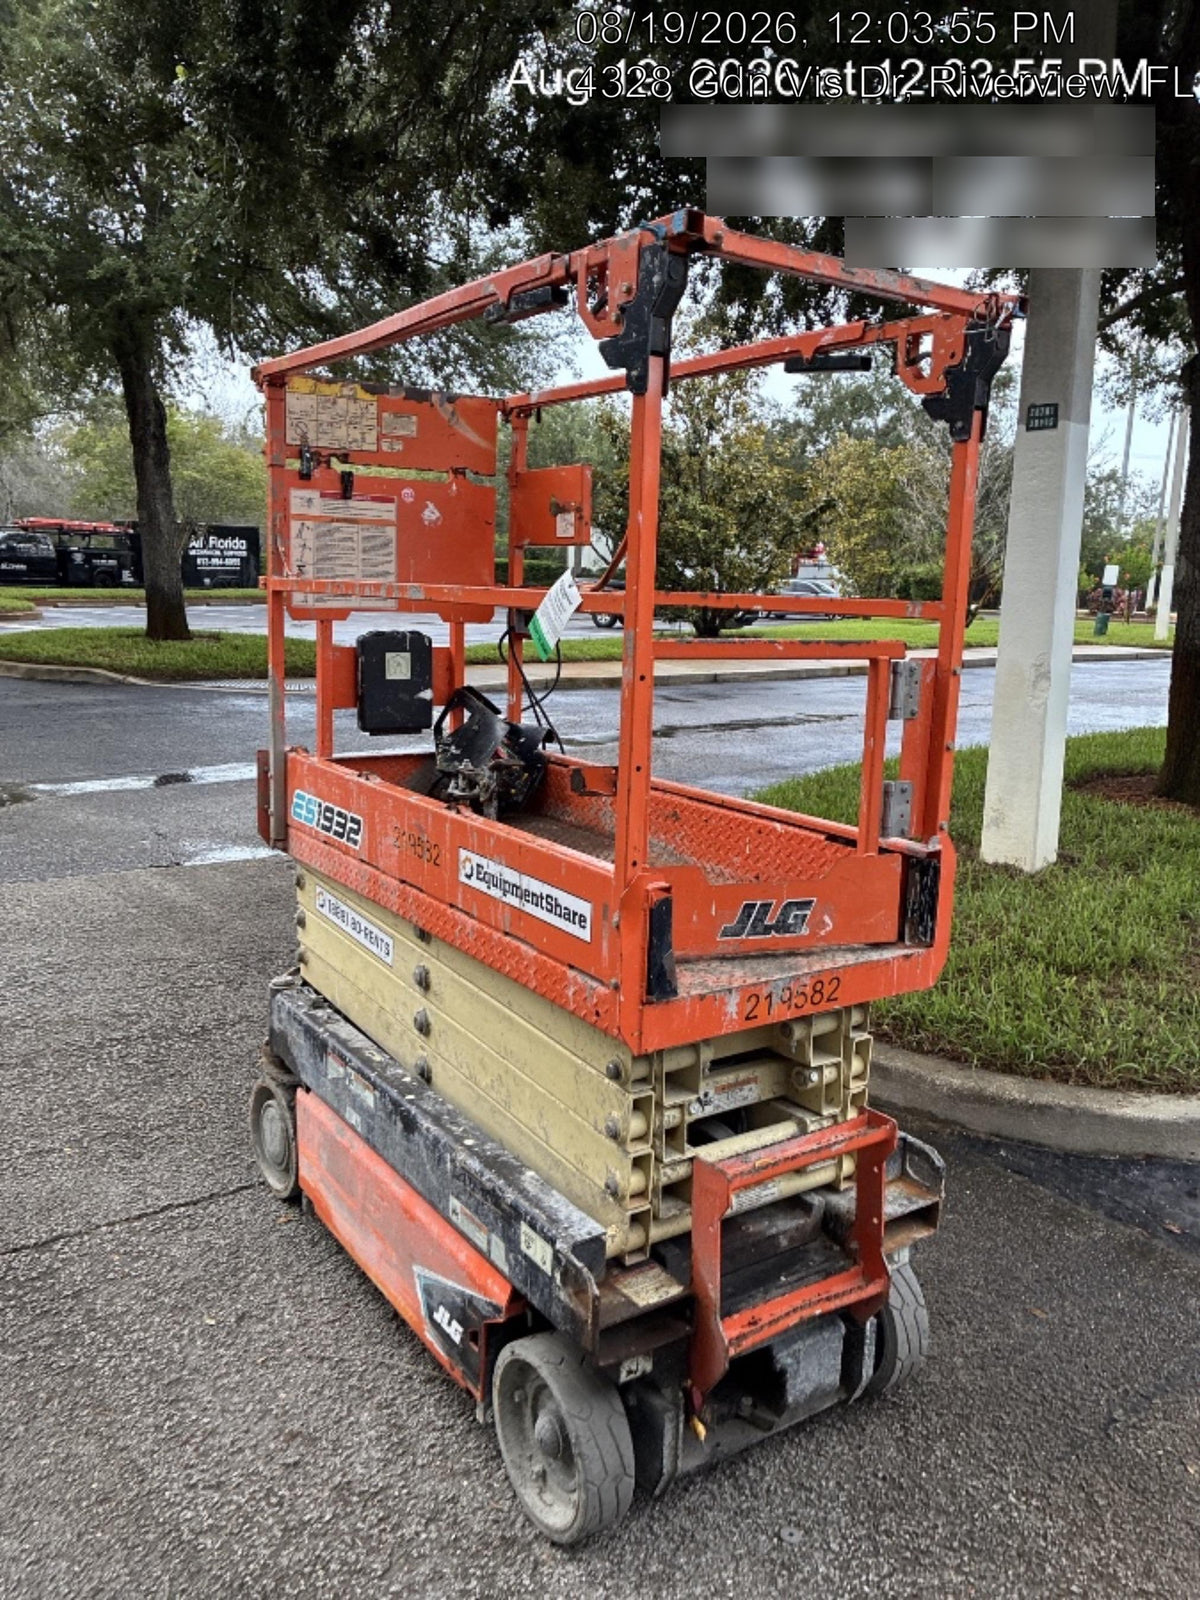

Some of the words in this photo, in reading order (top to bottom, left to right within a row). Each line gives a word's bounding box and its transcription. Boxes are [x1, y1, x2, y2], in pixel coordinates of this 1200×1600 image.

[209, 536, 247, 550] Florida
[291, 789, 363, 850] ES1932
[476, 862, 588, 930] EquipmentShare
[717, 898, 817, 941] JLG
[744, 975, 841, 1021] 219582
[433, 1304, 464, 1346] JLG
